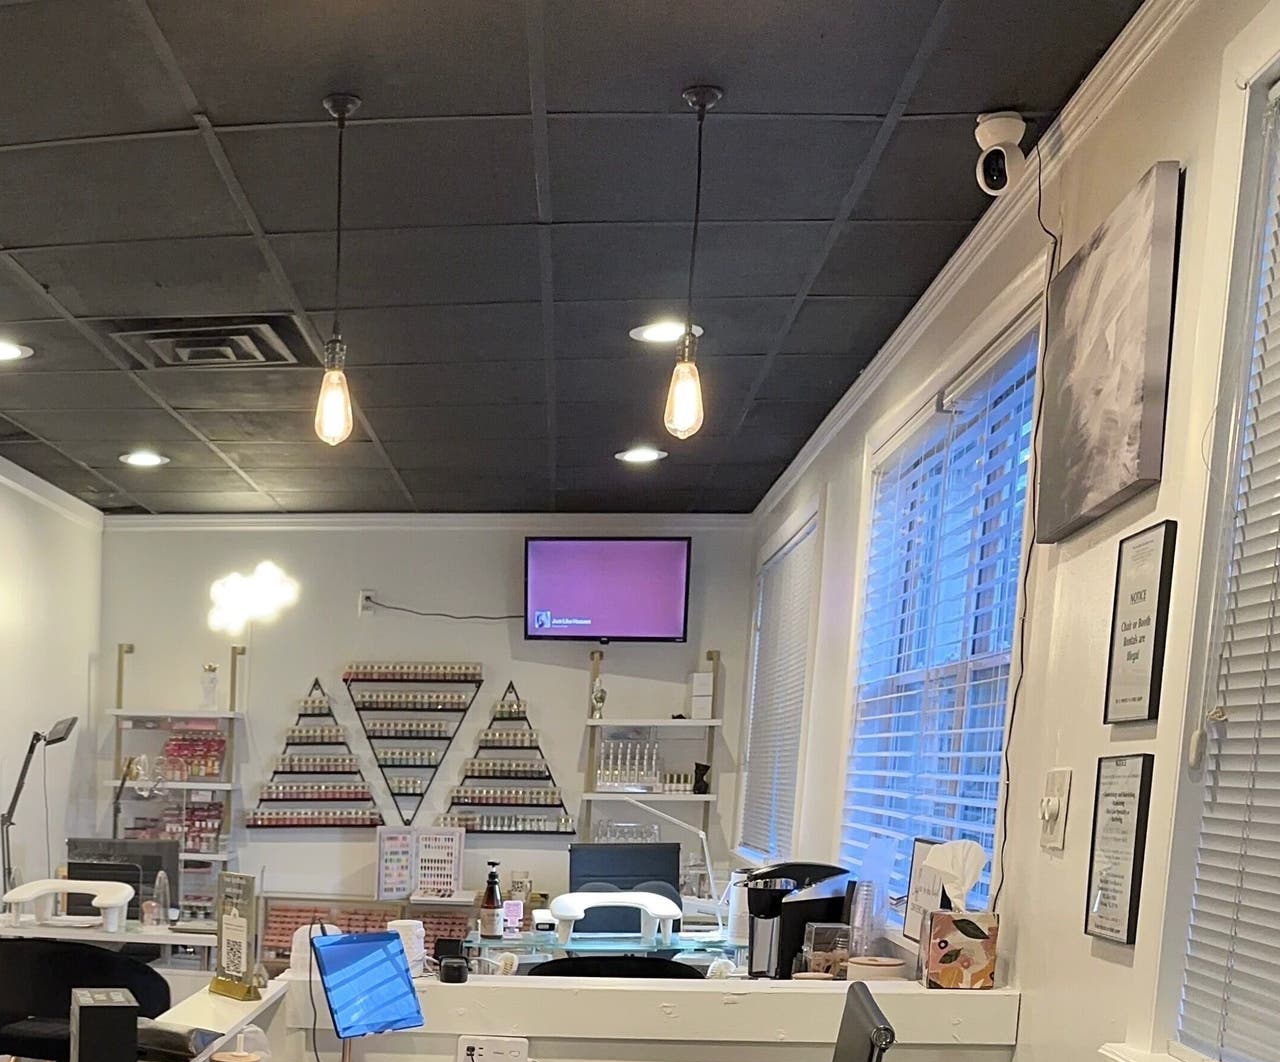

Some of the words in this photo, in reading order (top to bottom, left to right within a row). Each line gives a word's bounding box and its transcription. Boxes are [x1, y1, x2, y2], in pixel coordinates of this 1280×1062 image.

[1130, 589, 1147, 602] NOTICE
[1121, 620, 1132, 632] Chair
[1138, 615, 1151, 628] Booth
